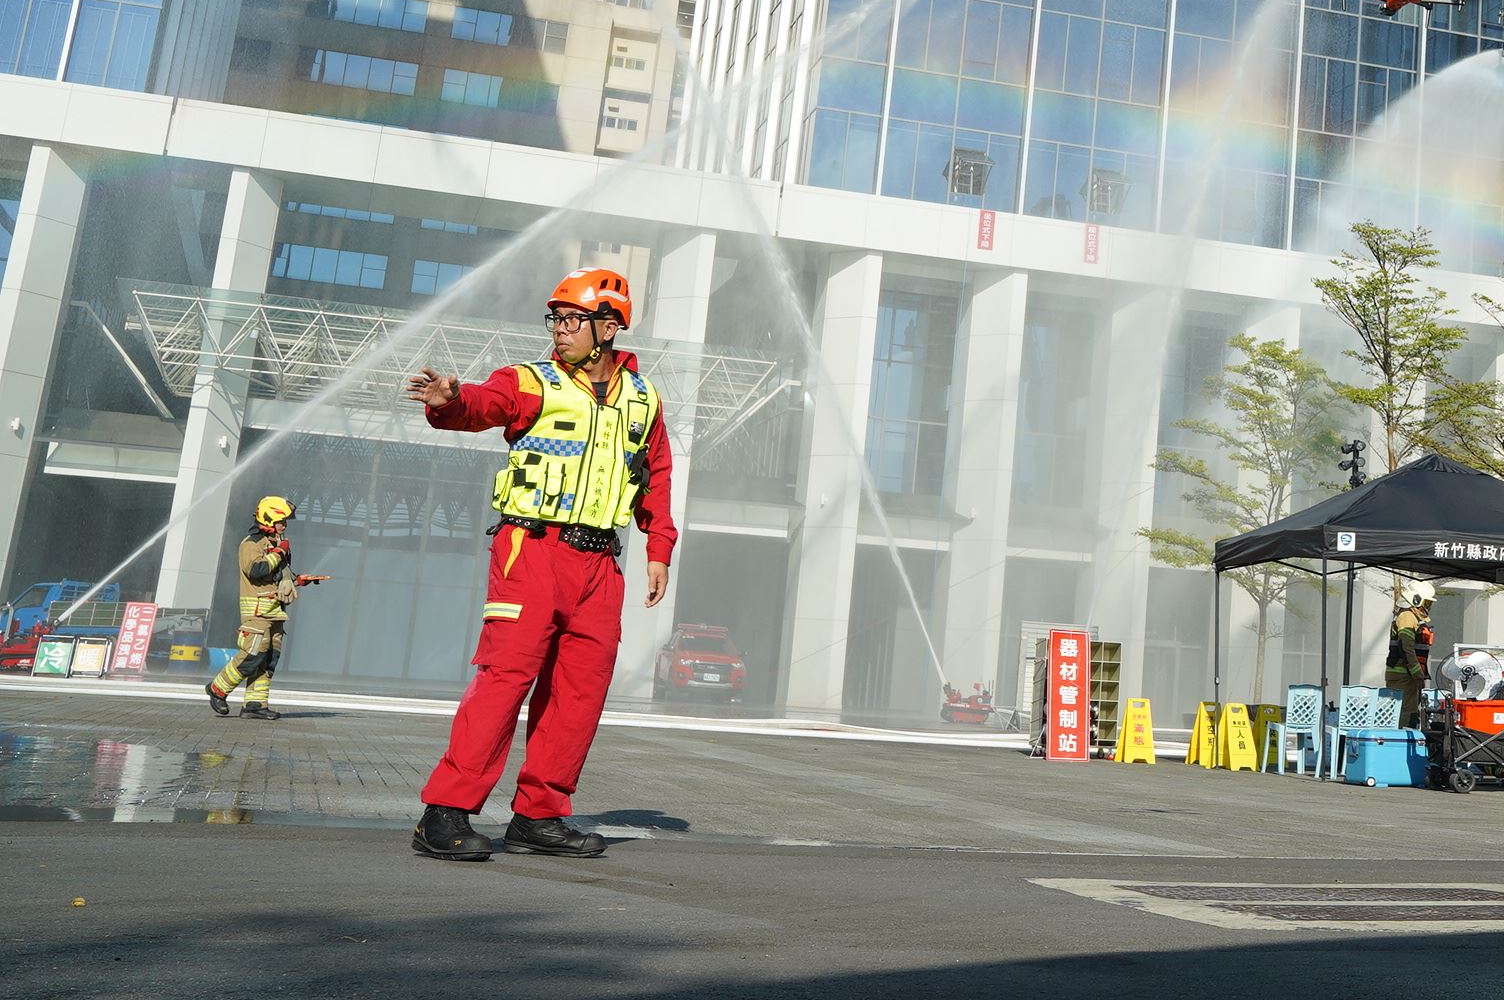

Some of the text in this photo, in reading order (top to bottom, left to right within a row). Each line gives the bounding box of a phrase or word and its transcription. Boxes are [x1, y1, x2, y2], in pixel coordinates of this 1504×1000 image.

[39, 646, 66, 669] 冷
[1058, 638, 1079, 753] 器材管制站
[1237, 729, 1246, 750] 人員
